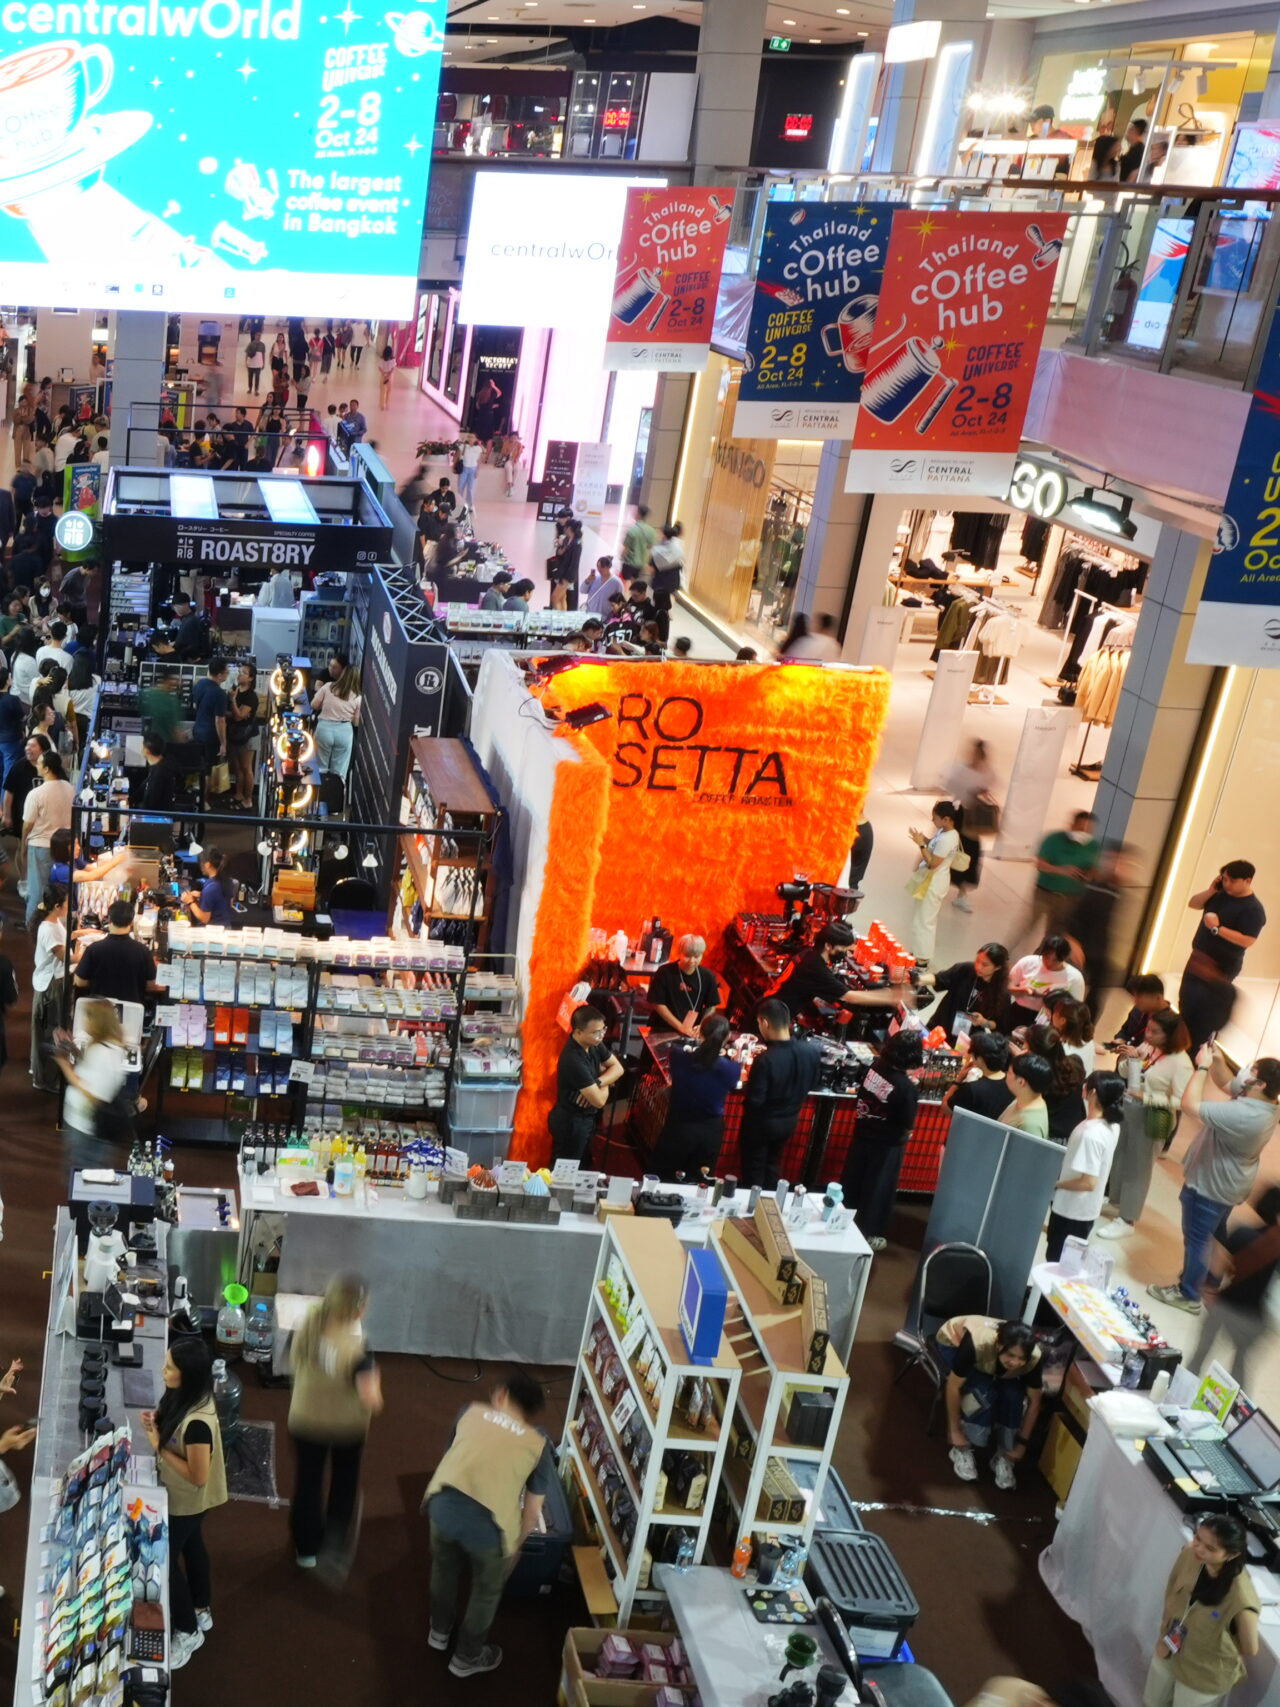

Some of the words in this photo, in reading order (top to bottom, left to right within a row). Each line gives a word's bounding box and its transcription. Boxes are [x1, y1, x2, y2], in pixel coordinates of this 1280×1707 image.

[2, 0, 302, 40] centralwOrld
[324, 42, 389, 69] COFFEE
[317, 91, 381, 129] 2-8
[315, 129, 350, 149] Oct
[354, 126, 378, 146] 24
[287, 169, 324, 190] The
[330, 170, 401, 196] largest
[285, 191, 343, 213] coffee
[346, 197, 399, 214] event
[643, 201, 705, 227] Thailand
[283, 211, 302, 231] in
[308, 212, 397, 238] Bangkok
[639, 219, 712, 247] cOffee
[789, 220, 872, 254] Thailand
[656, 240, 698, 264] hub
[783, 243, 880, 280] cOffee
[919, 234, 1018, 275] Thailand
[675, 271, 711, 284] COFFEE
[806, 270, 860, 302] hub
[910, 263, 1029, 306] cOffee
[670, 297, 705, 316] 2-8
[768, 309, 815, 327] COFFEE
[938, 294, 1003, 332] hub
[668, 317, 687, 328] Oct
[690, 316, 704, 325] 24
[765, 323, 812, 344] UNIVERSE
[760, 343, 807, 369] 2-8
[966, 341, 1024, 363] COFFEE
[758, 369, 781, 383] Oct
[789, 367, 804, 380] 24
[962, 357, 1020, 382] UNIVERSE
[955, 382, 1012, 412] 2-8
[802, 422, 838, 430] PATTANA
[803, 415, 840, 423] CENTRAL
[952, 413, 982, 429] Oct
[986, 412, 1007, 426] 24
[927, 474, 971, 483] PATTANA
[928, 466, 973, 476] CENTRAL
[1010, 462, 1067, 518] GO
[200, 540, 315, 565] ROAST8RY
[1240, 573, 1255, 583] All
[618, 693, 704, 742] RO
[612, 741, 788, 796] SETTA
